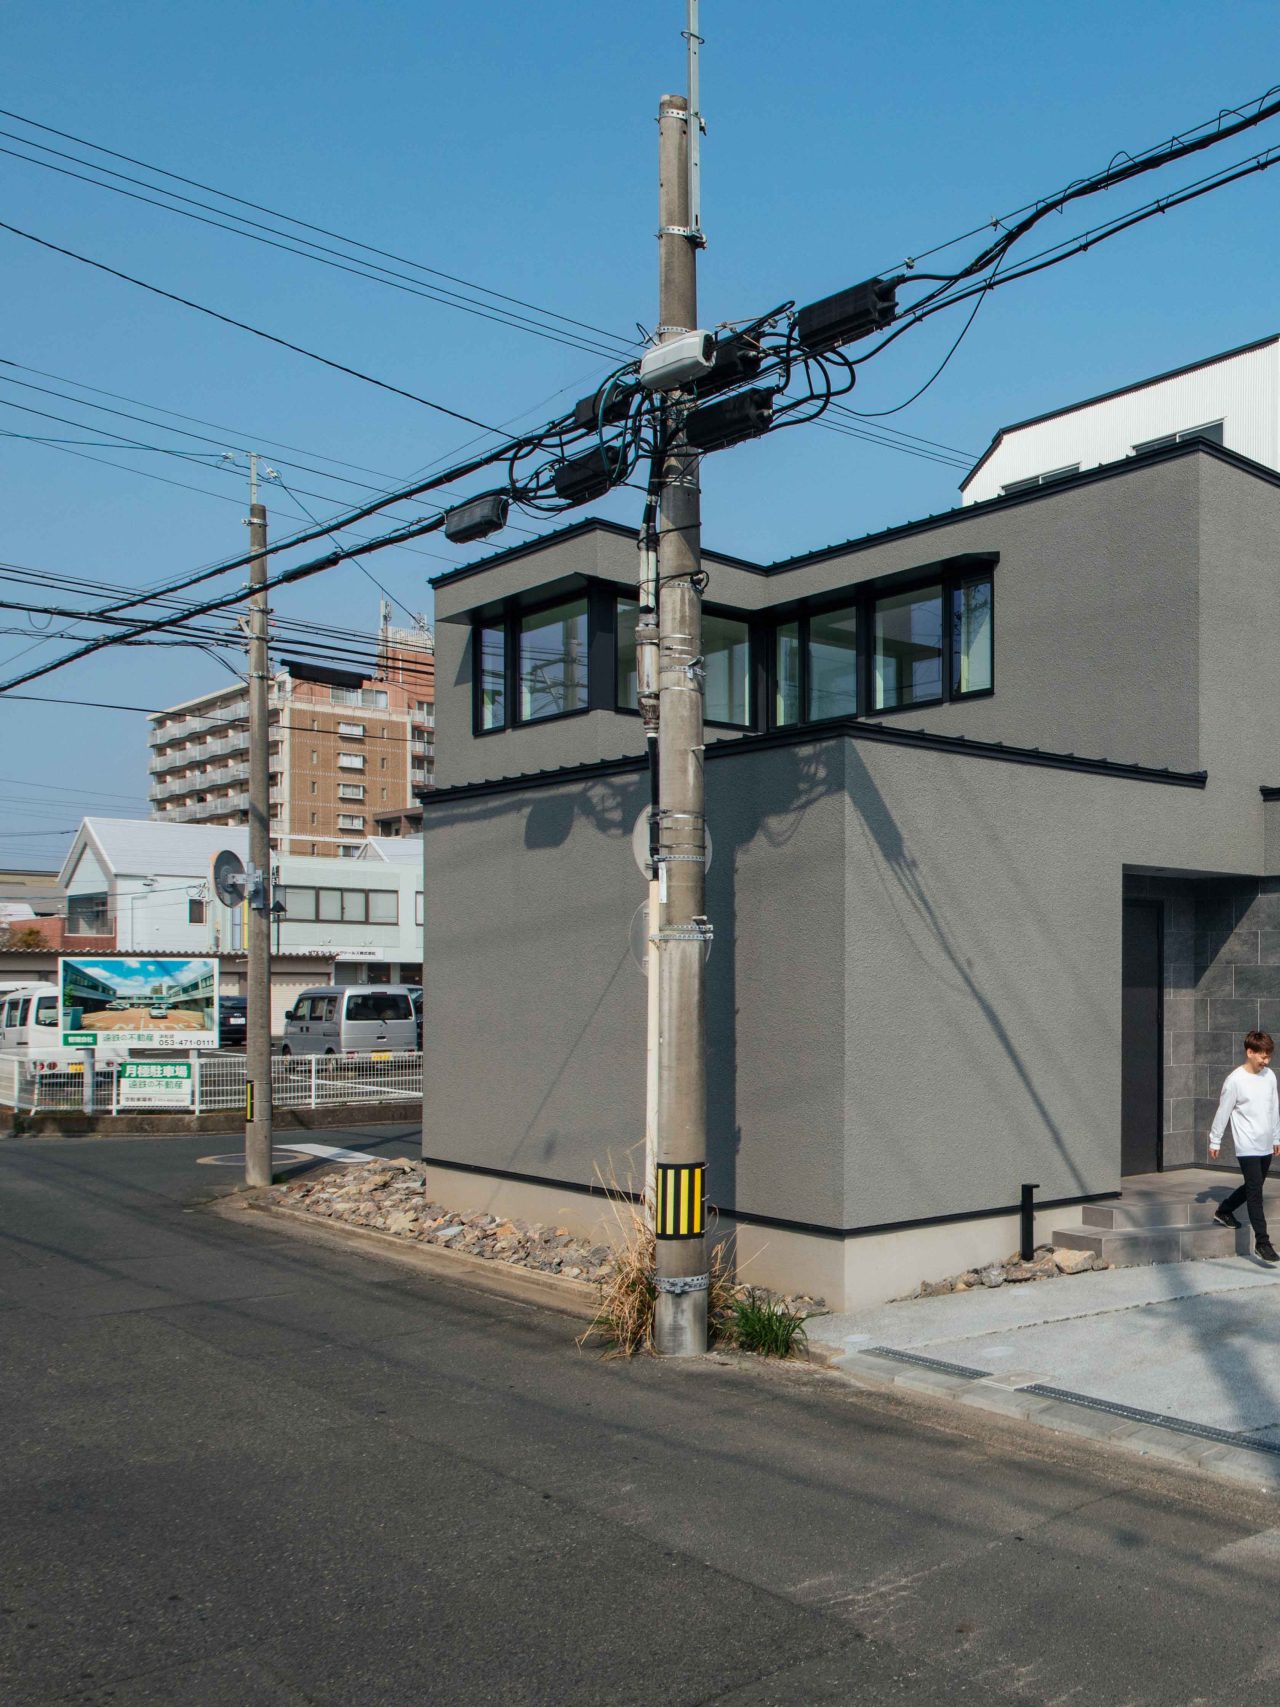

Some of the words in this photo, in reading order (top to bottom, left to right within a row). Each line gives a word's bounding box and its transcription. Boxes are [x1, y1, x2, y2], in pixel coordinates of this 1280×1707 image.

[125, 1064, 188, 1078] 月極駐車場
